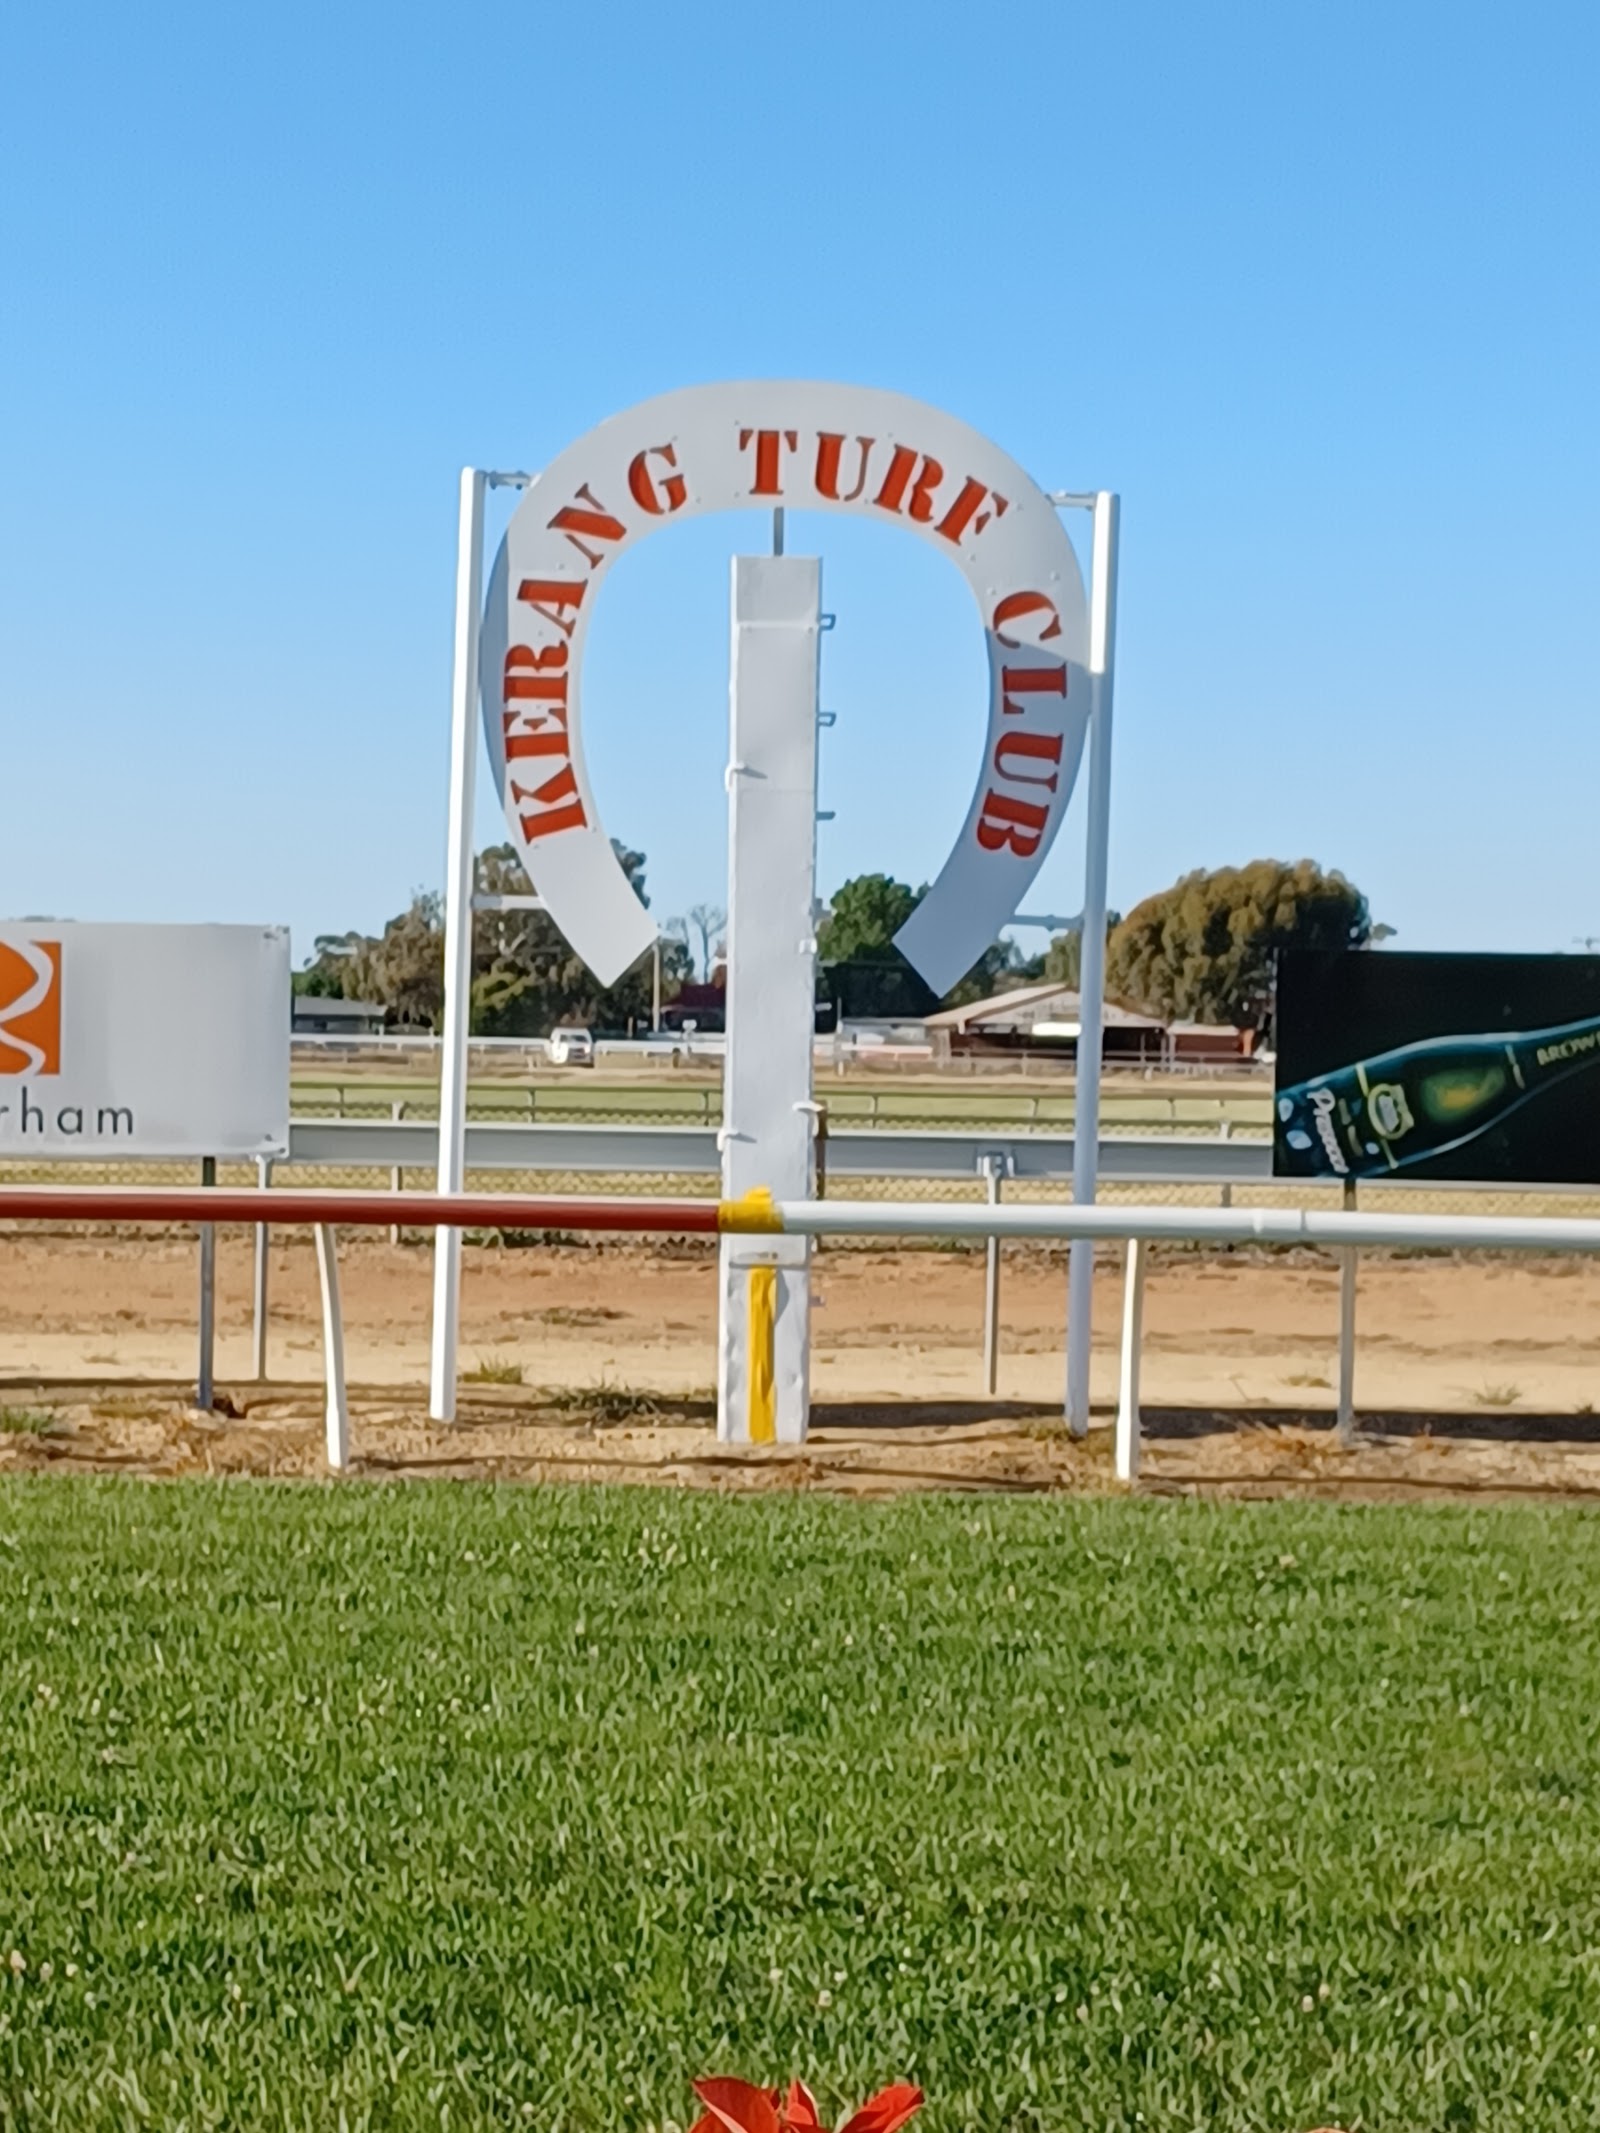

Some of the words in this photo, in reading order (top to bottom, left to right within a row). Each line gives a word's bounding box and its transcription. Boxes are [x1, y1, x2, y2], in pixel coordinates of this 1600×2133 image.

[504, 443, 688, 845] KERANG
[739, 430, 1008, 546] TURF
[976, 590, 1069, 858] CLUB
